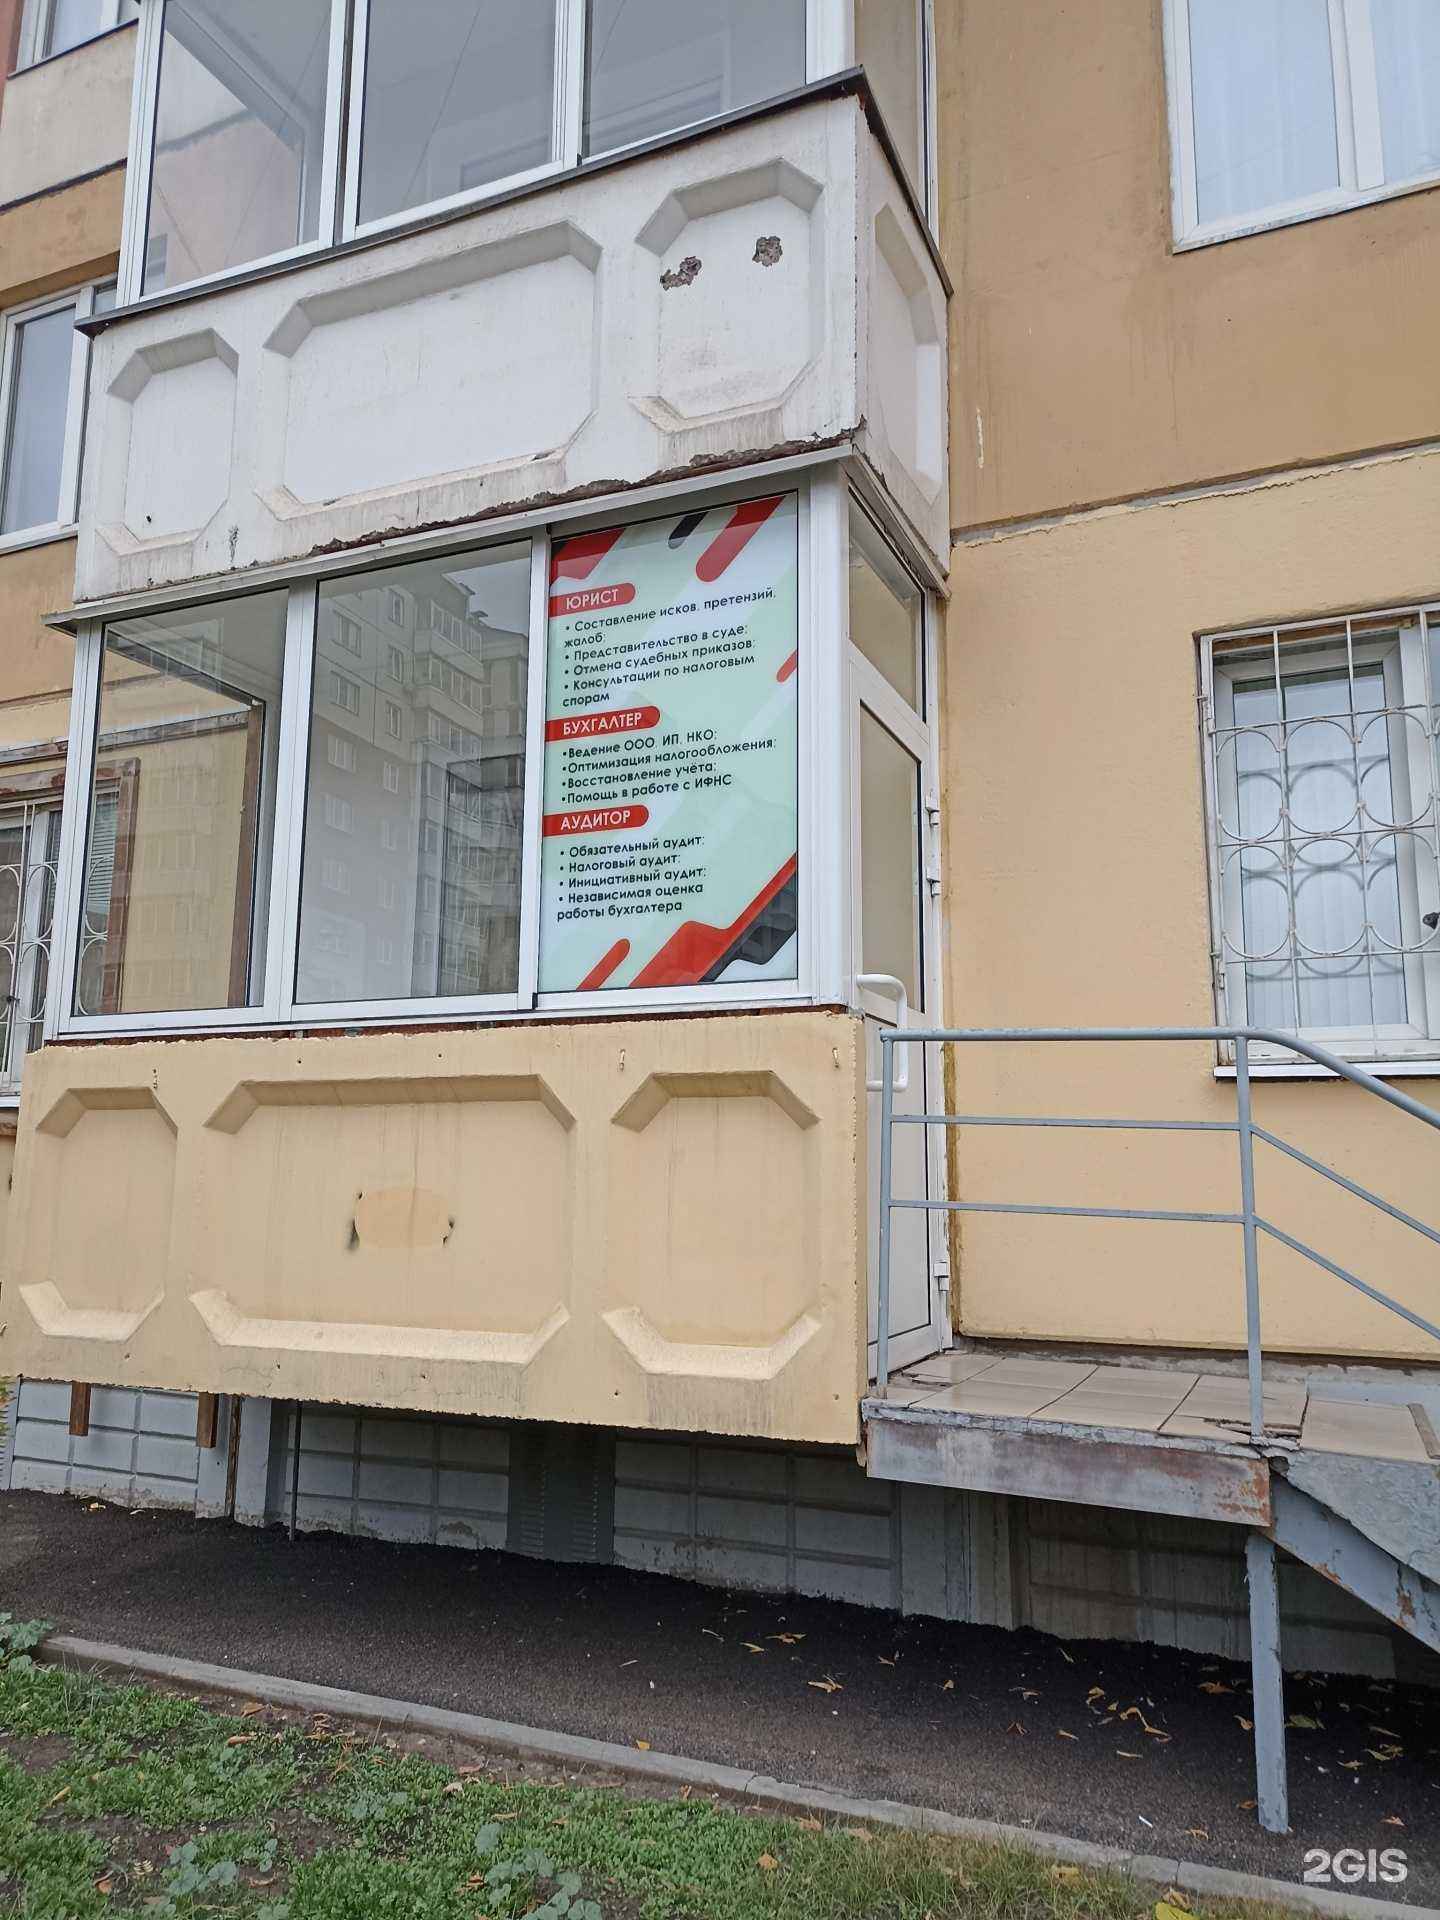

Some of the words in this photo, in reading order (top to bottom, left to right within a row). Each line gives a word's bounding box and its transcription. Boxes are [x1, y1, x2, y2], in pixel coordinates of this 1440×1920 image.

[566, 589, 619, 610] ЮРИСТ
[574, 610, 656, 632] Составление
[574, 634, 698, 661] Представительство
[702, 632, 708, 640] в
[573, 661, 621, 676] Отмена
[625, 651, 688, 668] судебных
[573, 671, 660, 690] Консультации
[664, 667, 679, 676] по
[683, 656, 755, 674] налоговым
[562, 692, 610, 707] спорам
[563, 712, 642, 735] БУХГАЛТЕР
[568, 744, 621, 758] Ведение
[568, 754, 651, 773] Оптимизация
[567, 789, 618, 803] Помощь
[622, 789, 628, 797] в
[632, 782, 679, 798] работе
[683, 781, 690, 790] с
[695, 774, 732, 788] ИФНС
[568, 768, 671, 789] Восстановление
[560, 810, 631, 831] АУДИТОР
[569, 838, 659, 857] Обязательный
[569, 856, 636, 873] Налоговый
[568, 870, 661, 888] Инициативный
[568, 887, 651, 903] Независимая
[655, 884, 704, 897] оценка
[557, 908, 604, 922] работы
[608, 901, 683, 916] бухгалтера
